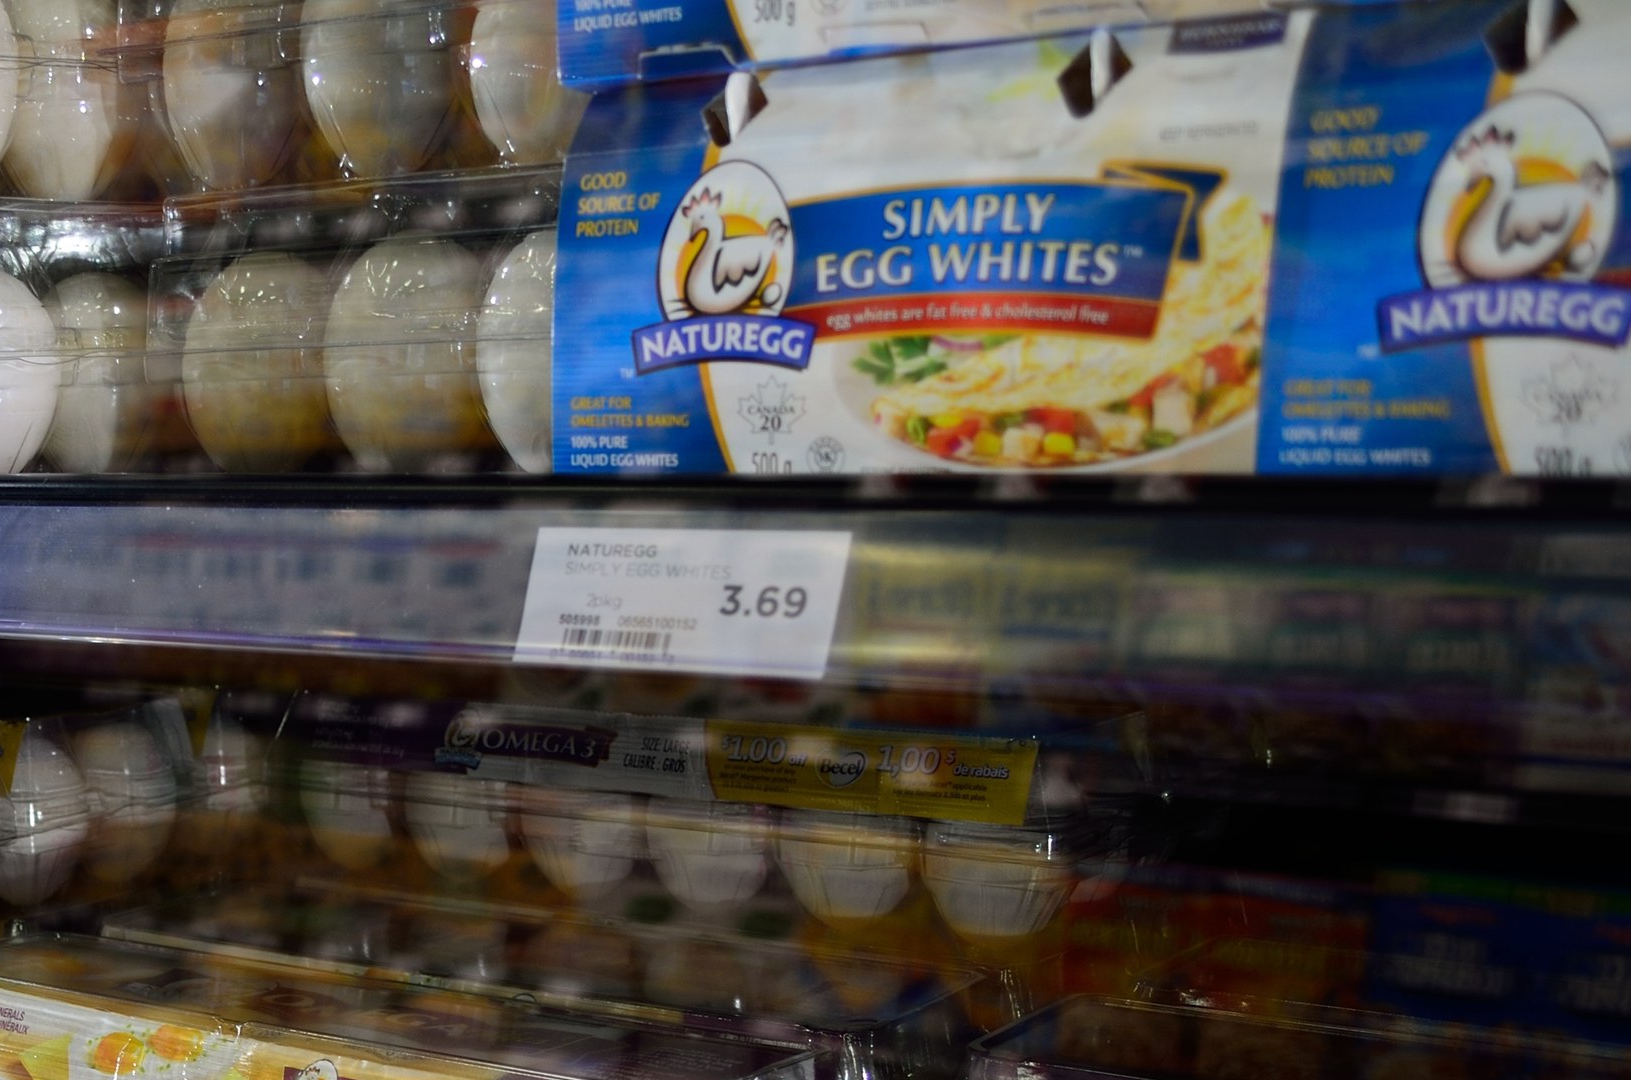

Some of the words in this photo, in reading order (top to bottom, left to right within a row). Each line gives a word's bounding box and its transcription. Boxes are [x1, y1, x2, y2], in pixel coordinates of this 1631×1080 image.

[574, 14, 611, 32] LIQUID
[642, 6, 682, 25] WHITES
[580, 172, 626, 191] GOOD
[577, 194, 635, 215] SOURCE
[638, 193, 660, 210] OF
[882, 192, 1055, 241] SIMPLY
[576, 219, 639, 238] PROTEIN
[815, 245, 912, 294] EGG
[826, 312, 851, 330] egg
[853, 308, 898, 324] whites
[901, 307, 921, 321] are
[926, 303, 948, 320] fat
[950, 302, 978, 319] free
[994, 303, 1076, 322] cholesterol
[1078, 306, 1109, 324] free
[1390, 290, 1625, 339] NATUREGG
[641, 322, 806, 362] NATUREGG
[571, 397, 606, 409] GREAT
[571, 414, 633, 428] OMELETTES
[645, 413, 689, 427] BAKING
[760, 416, 781, 432] 20
[600, 435, 628, 449] PURE
[571, 454, 608, 467] LIQUID
[610, 454, 632, 466] EGG
[635, 453, 678, 467] WHITES
[568, 543, 658, 559] NATUREGG
[564, 562, 621, 577] SIMPLY
[626, 562, 660, 578] EGG
[666, 564, 733, 580] WHITES
[717, 583, 810, 620] 3.69
[482, 728, 576, 756] OMEGA
[663, 737, 689, 755] LARGE
[721, 734, 788, 764] $1.00
[623, 753, 656, 770] CALIBRE
[663, 756, 686, 773] GROS
[820, 754, 862, 776] Becel
[877, 744, 940, 776] 1,00
[971, 764, 1010, 780] rabais
